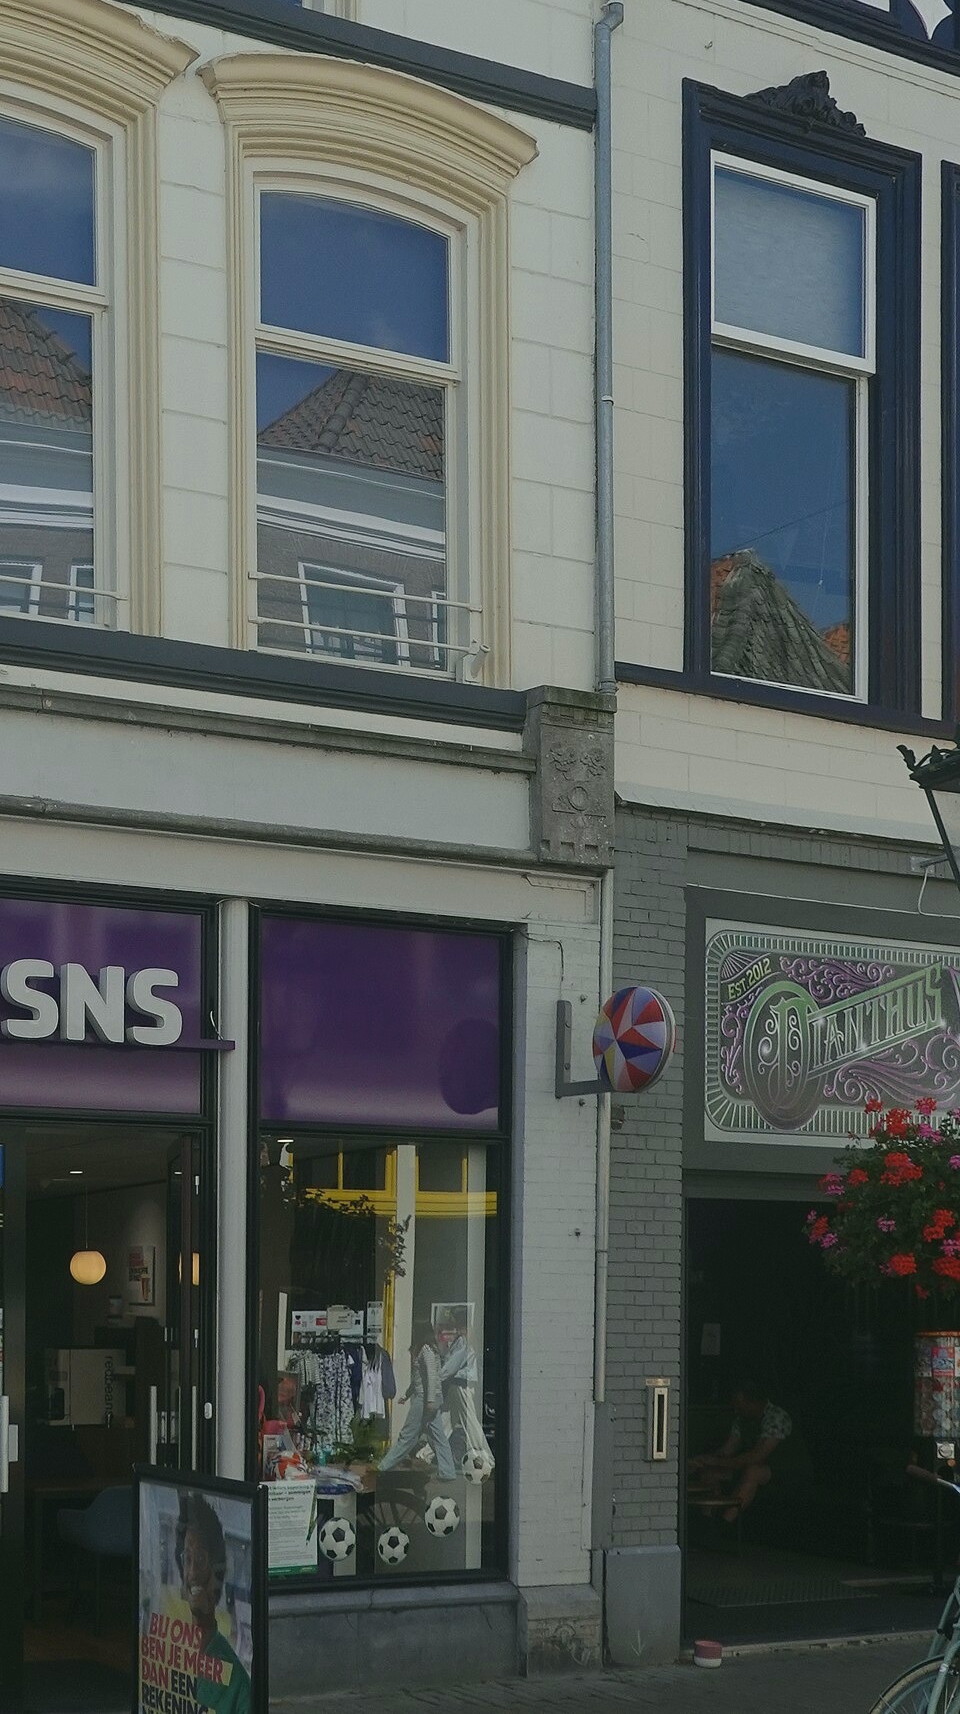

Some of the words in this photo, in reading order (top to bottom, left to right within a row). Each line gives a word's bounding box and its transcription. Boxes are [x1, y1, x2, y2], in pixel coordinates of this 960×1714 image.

[0, 958, 183, 1046] SNS
[150, 1612, 171, 1639] BIJ
[171, 1618, 203, 1650] ONS
[142, 1636, 165, 1663] BEN
[167, 1643, 182, 1670] JE
[184, 1649, 223, 1685] MEER
[142, 1657, 169, 1690] DAN
[171, 1669, 198, 1700] EEN
